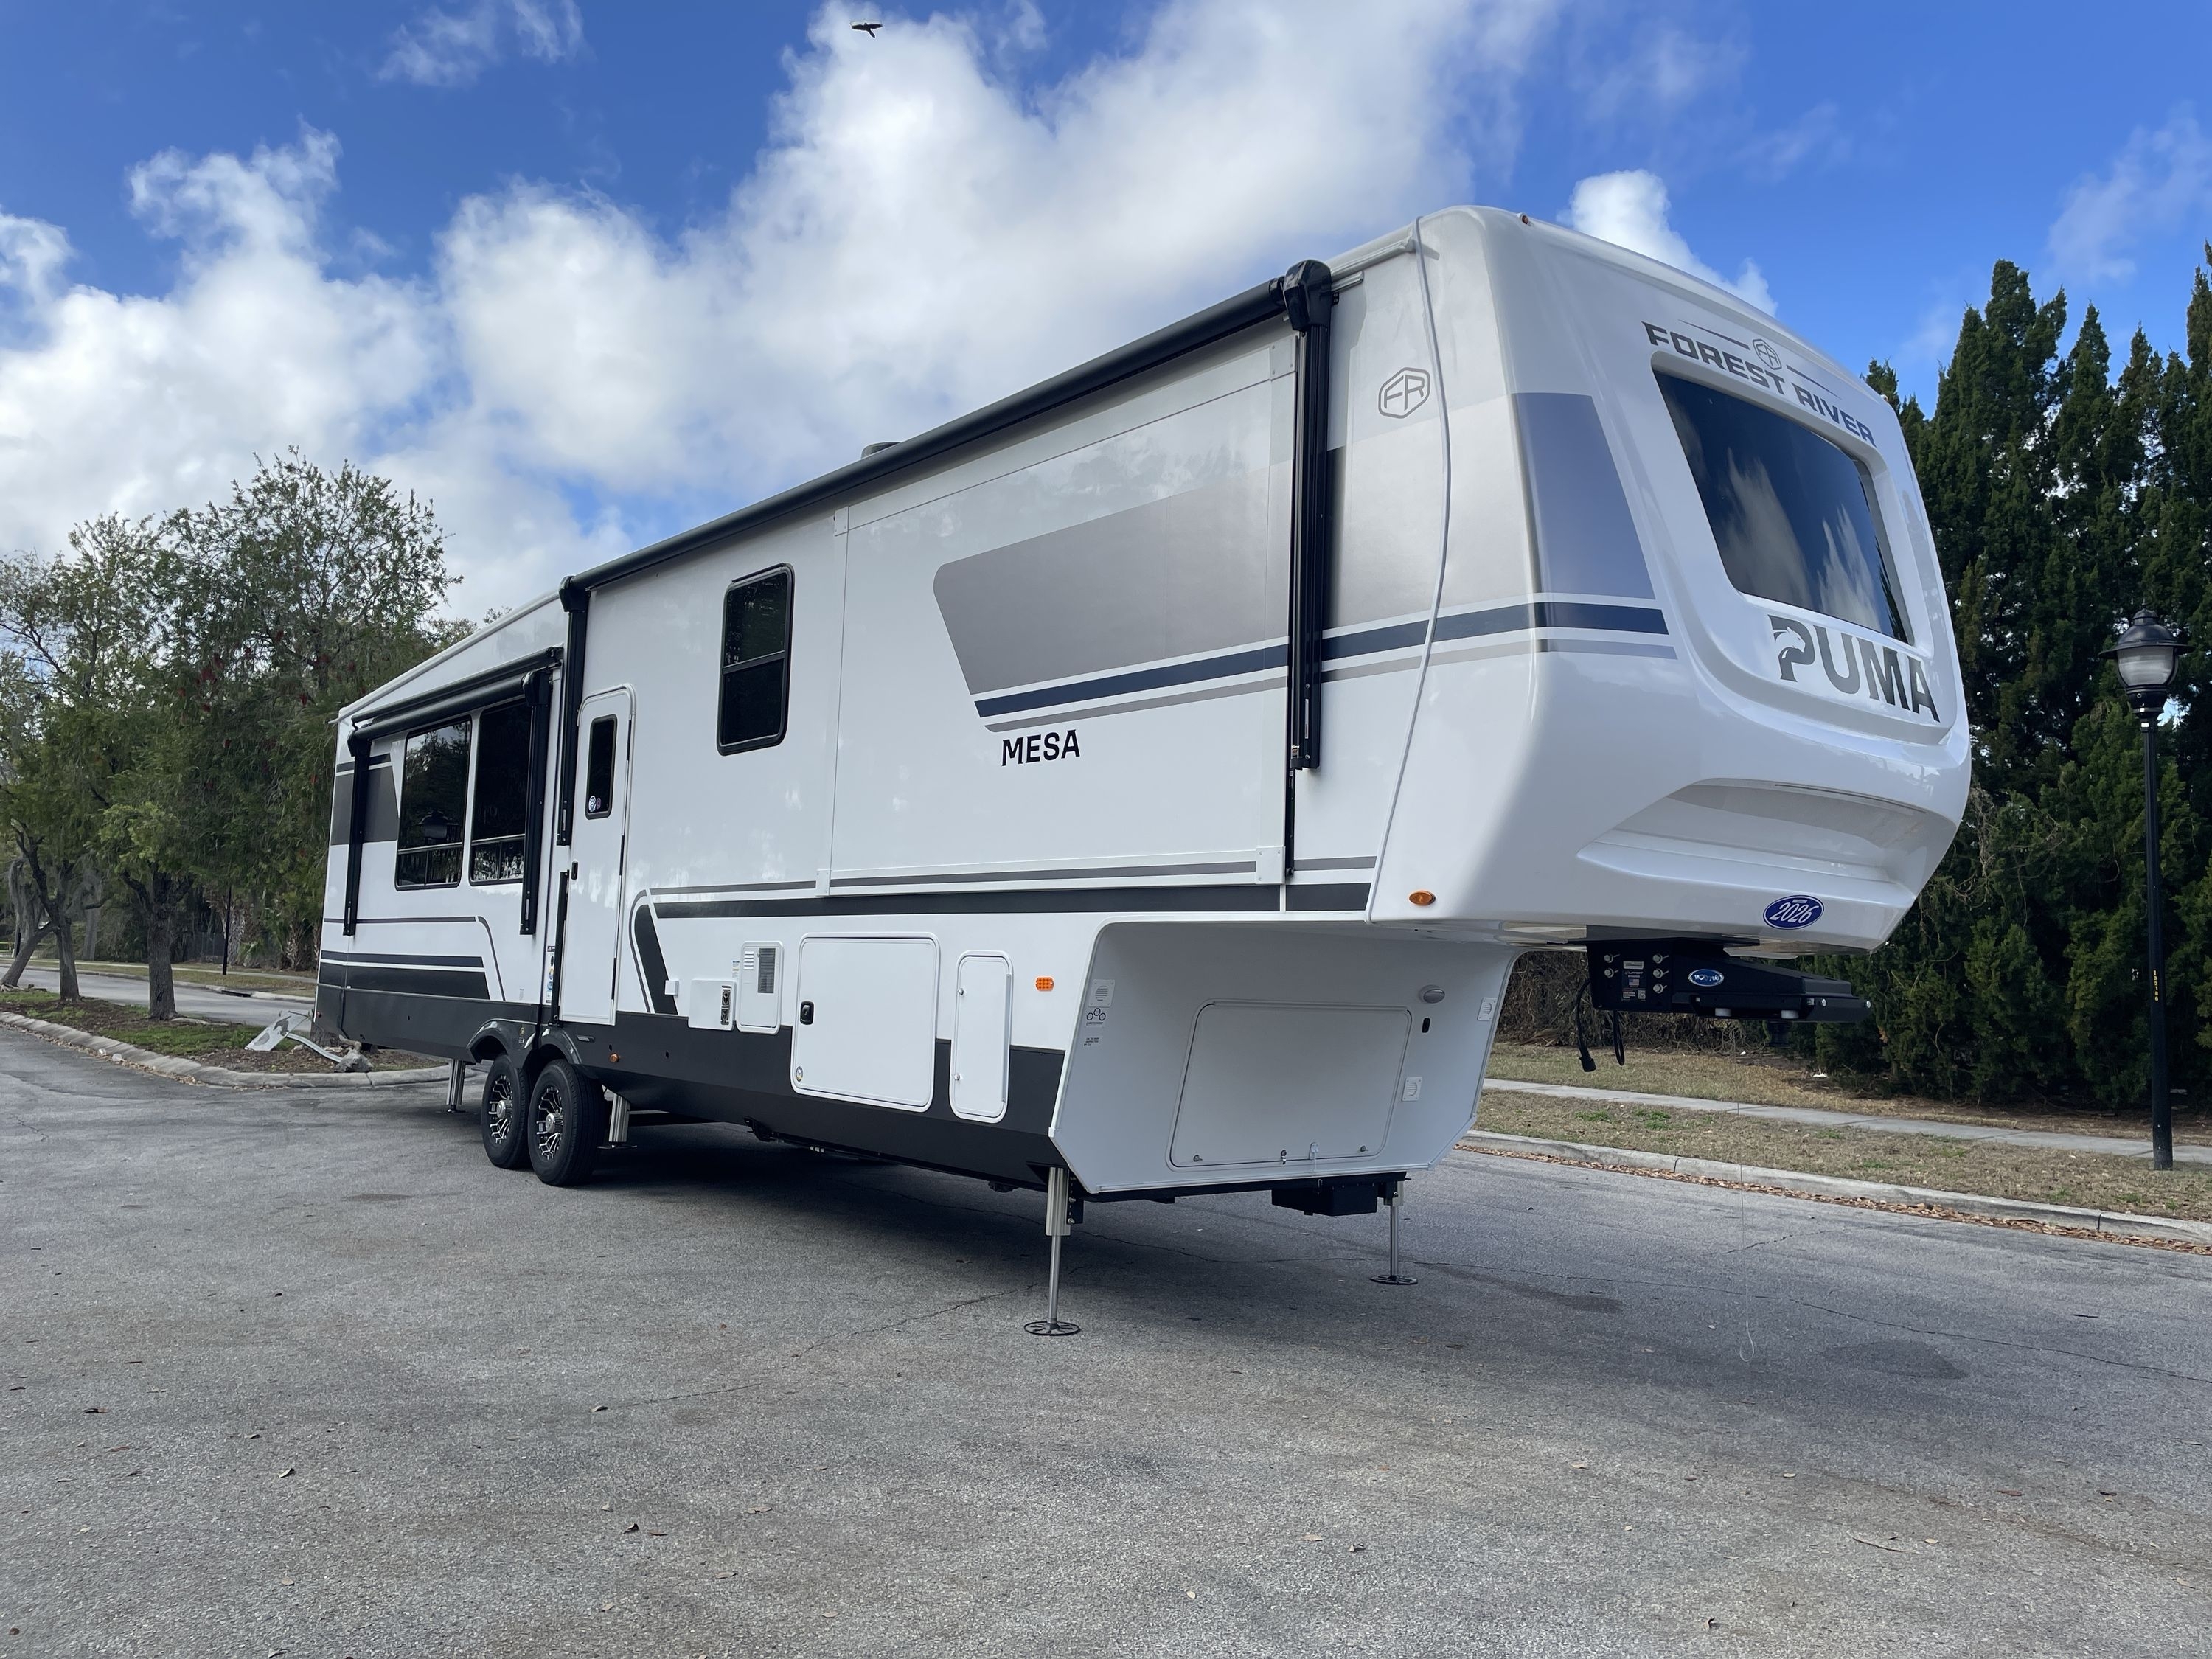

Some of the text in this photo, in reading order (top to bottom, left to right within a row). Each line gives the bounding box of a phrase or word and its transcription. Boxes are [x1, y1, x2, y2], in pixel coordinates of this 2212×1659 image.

[1384, 375, 1425, 411] FR
[1641, 321, 1877, 448] FOREST RIVER
[1767, 614, 1940, 723] PUMA
[1001, 728, 1080, 767] MESA
[1769, 902, 1819, 924] 2026
